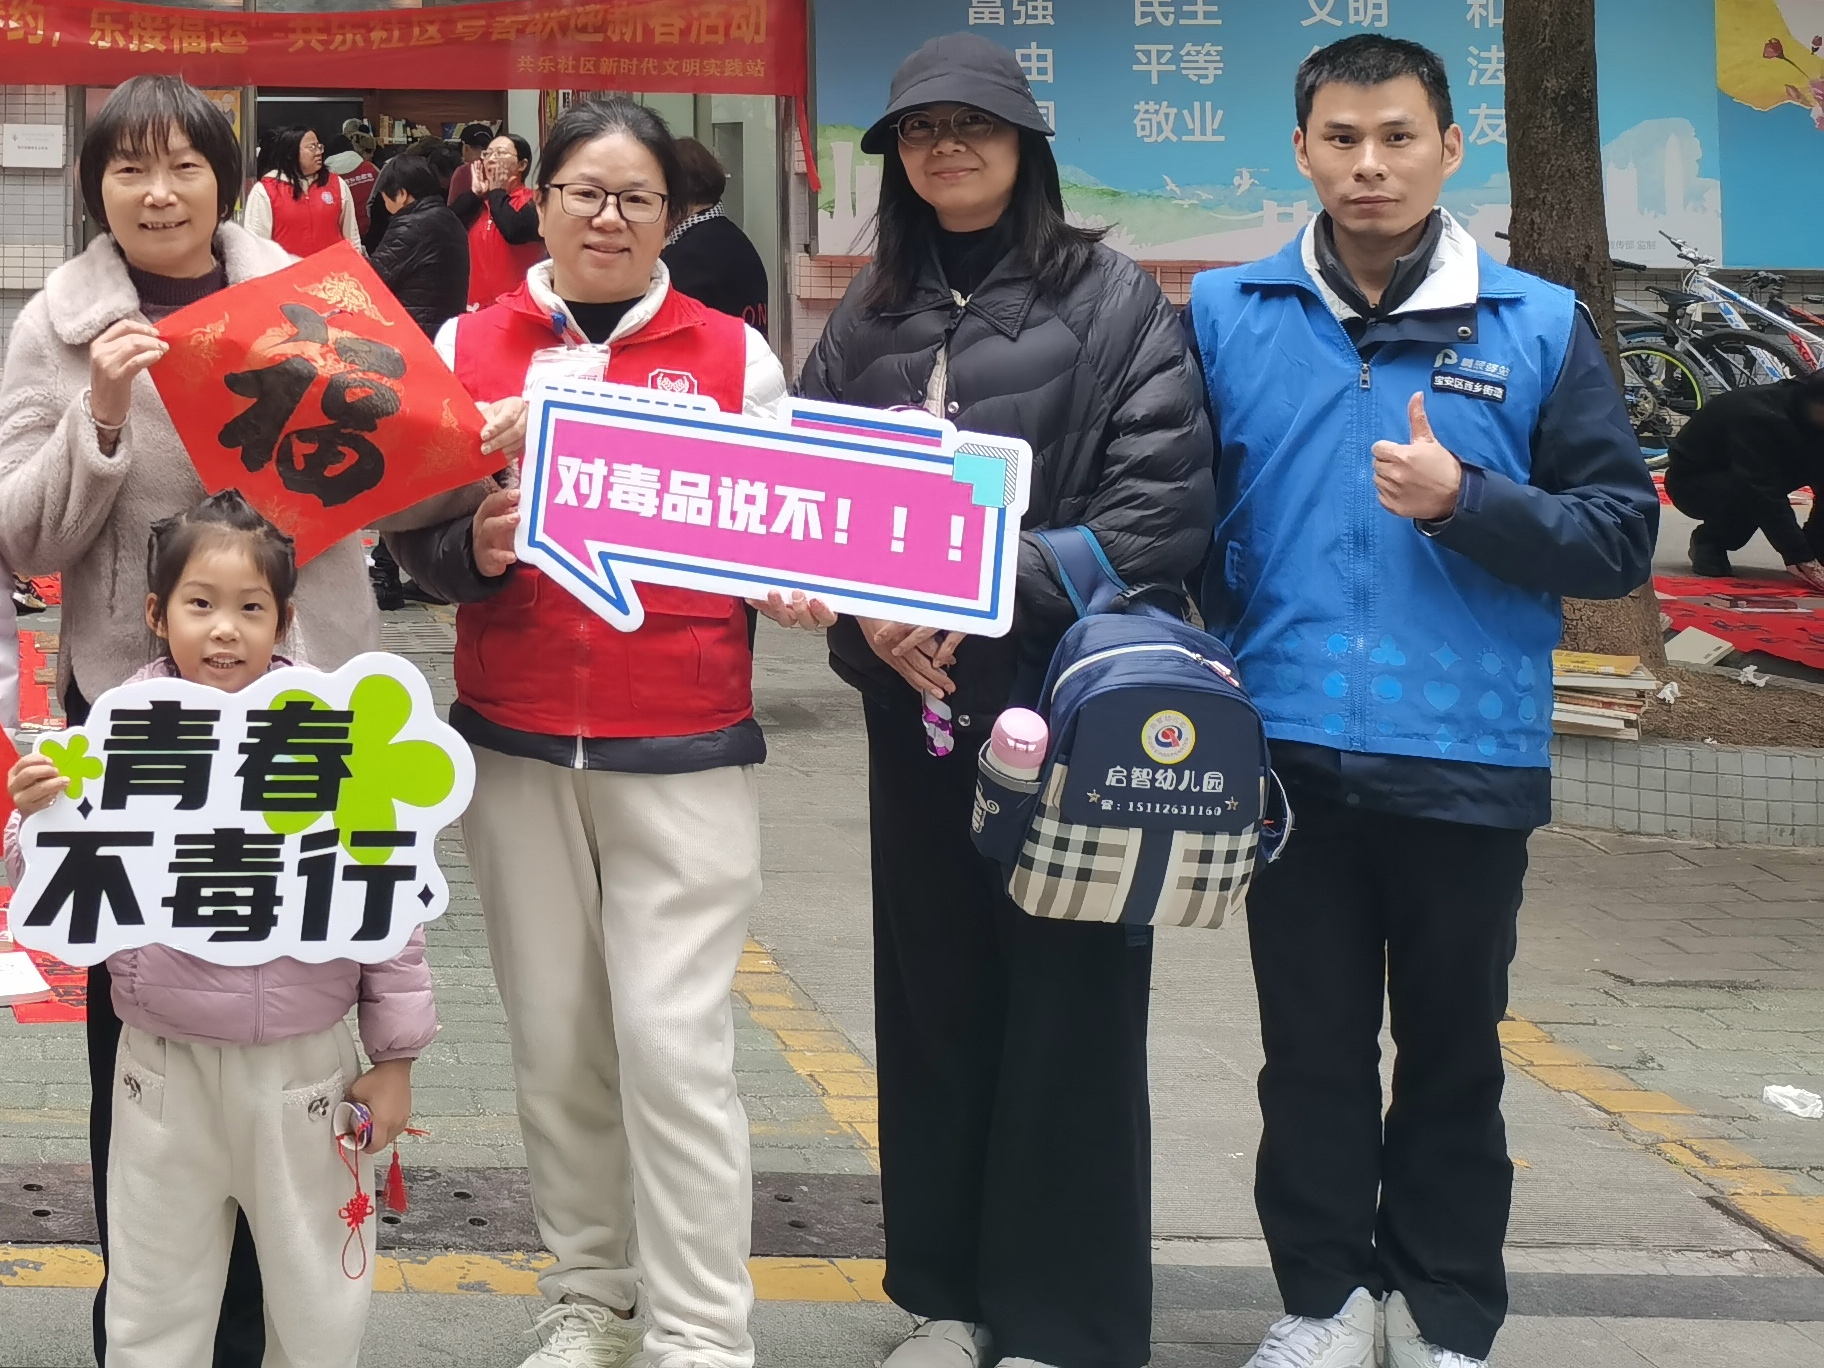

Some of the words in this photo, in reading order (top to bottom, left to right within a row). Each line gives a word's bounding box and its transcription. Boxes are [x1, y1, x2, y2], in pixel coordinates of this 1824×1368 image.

[516, 55, 766, 78] 共乐社区新时代文明实践站
[1014, 41, 1054, 84] 由
[1132, 42, 1224, 85] 平等
[1467, 45, 1505, 86] 法
[1133, 100, 1226, 143] 敬业
[1468, 103, 1507, 146] 友
[218, 301, 407, 508] 福
[553, 455, 966, 563] 对毒品说不！！！
[100, 700, 355, 812] 青春
[1105, 764, 1224, 793] 启智幼儿园
[22, 827, 418, 945] 不毒行
